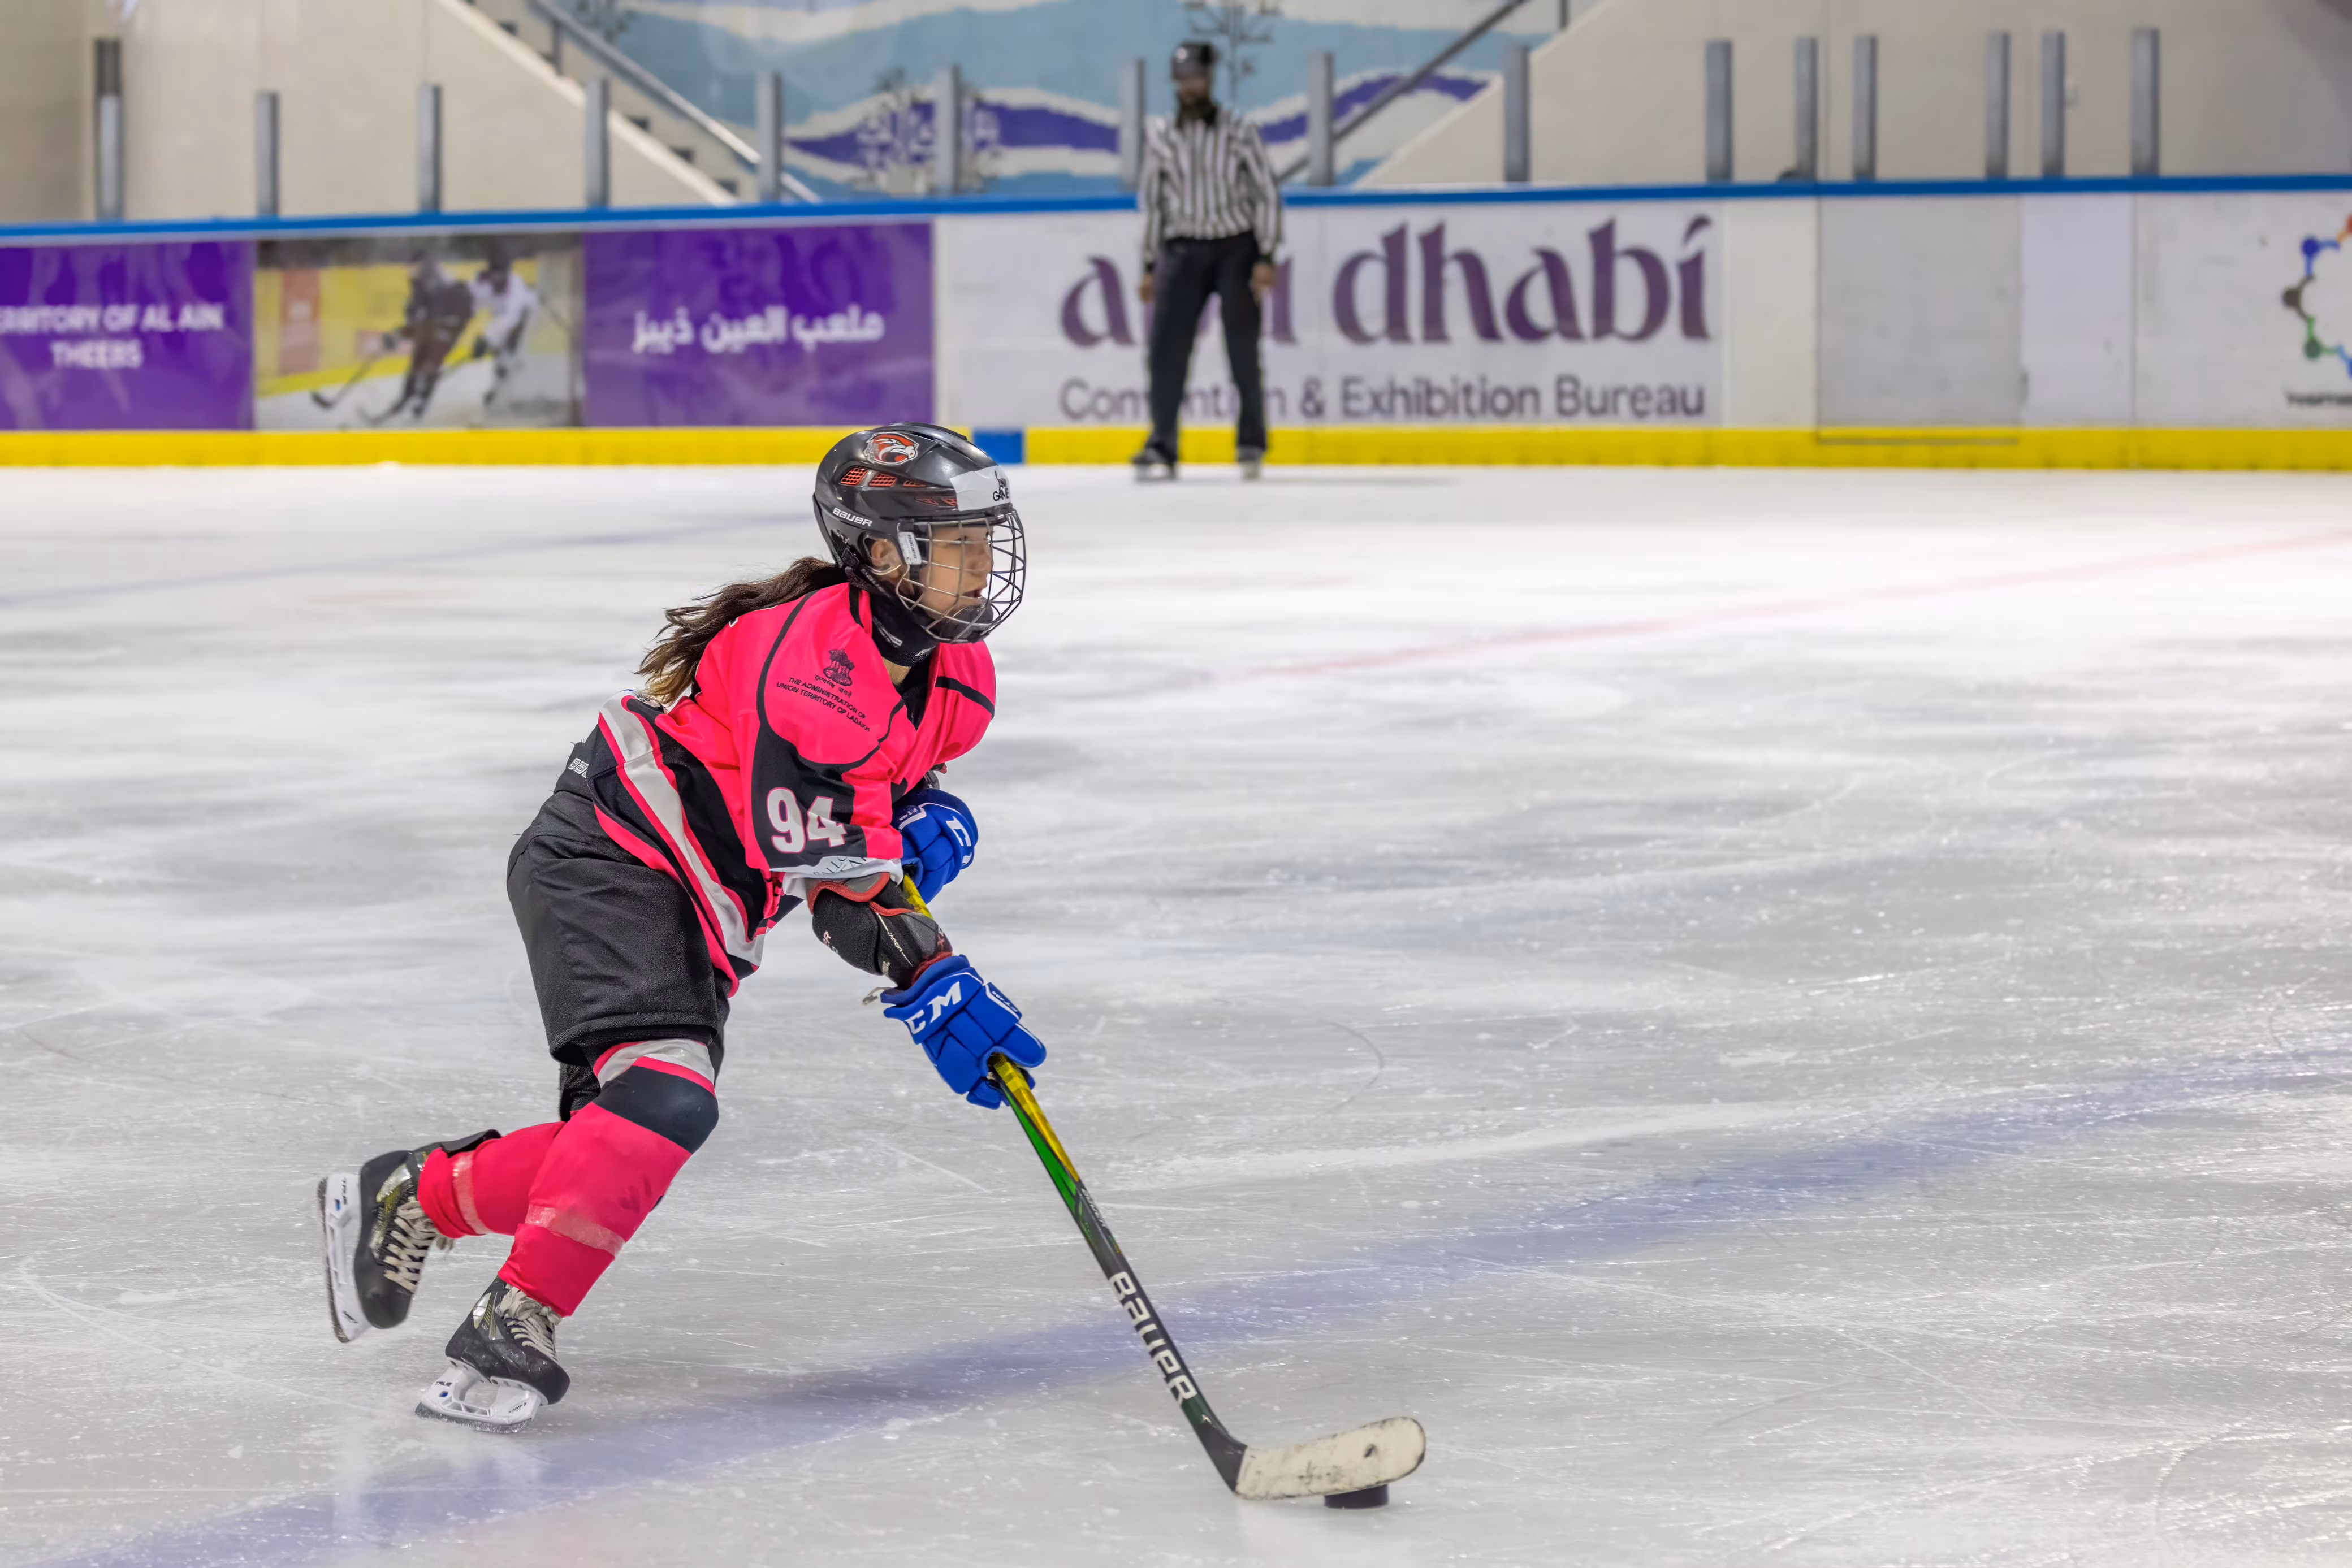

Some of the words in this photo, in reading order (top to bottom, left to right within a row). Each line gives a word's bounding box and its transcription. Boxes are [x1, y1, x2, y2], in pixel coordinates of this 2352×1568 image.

[102, 304, 139, 333] OF
[140, 304, 173, 333] AL
[1059, 377, 1287, 420] Conntin
[1299, 377, 1325, 418] &
[1341, 376, 1541, 418] Exhibition
[1555, 374, 1705, 417] Bureau
[776, 681, 799, 694] UNION
[800, 689, 837, 709] TERRITORY
[788, 677, 802, 686] THE
[801, 682, 858, 714] ADMINISTRATION
[767, 786, 847, 853] 94
